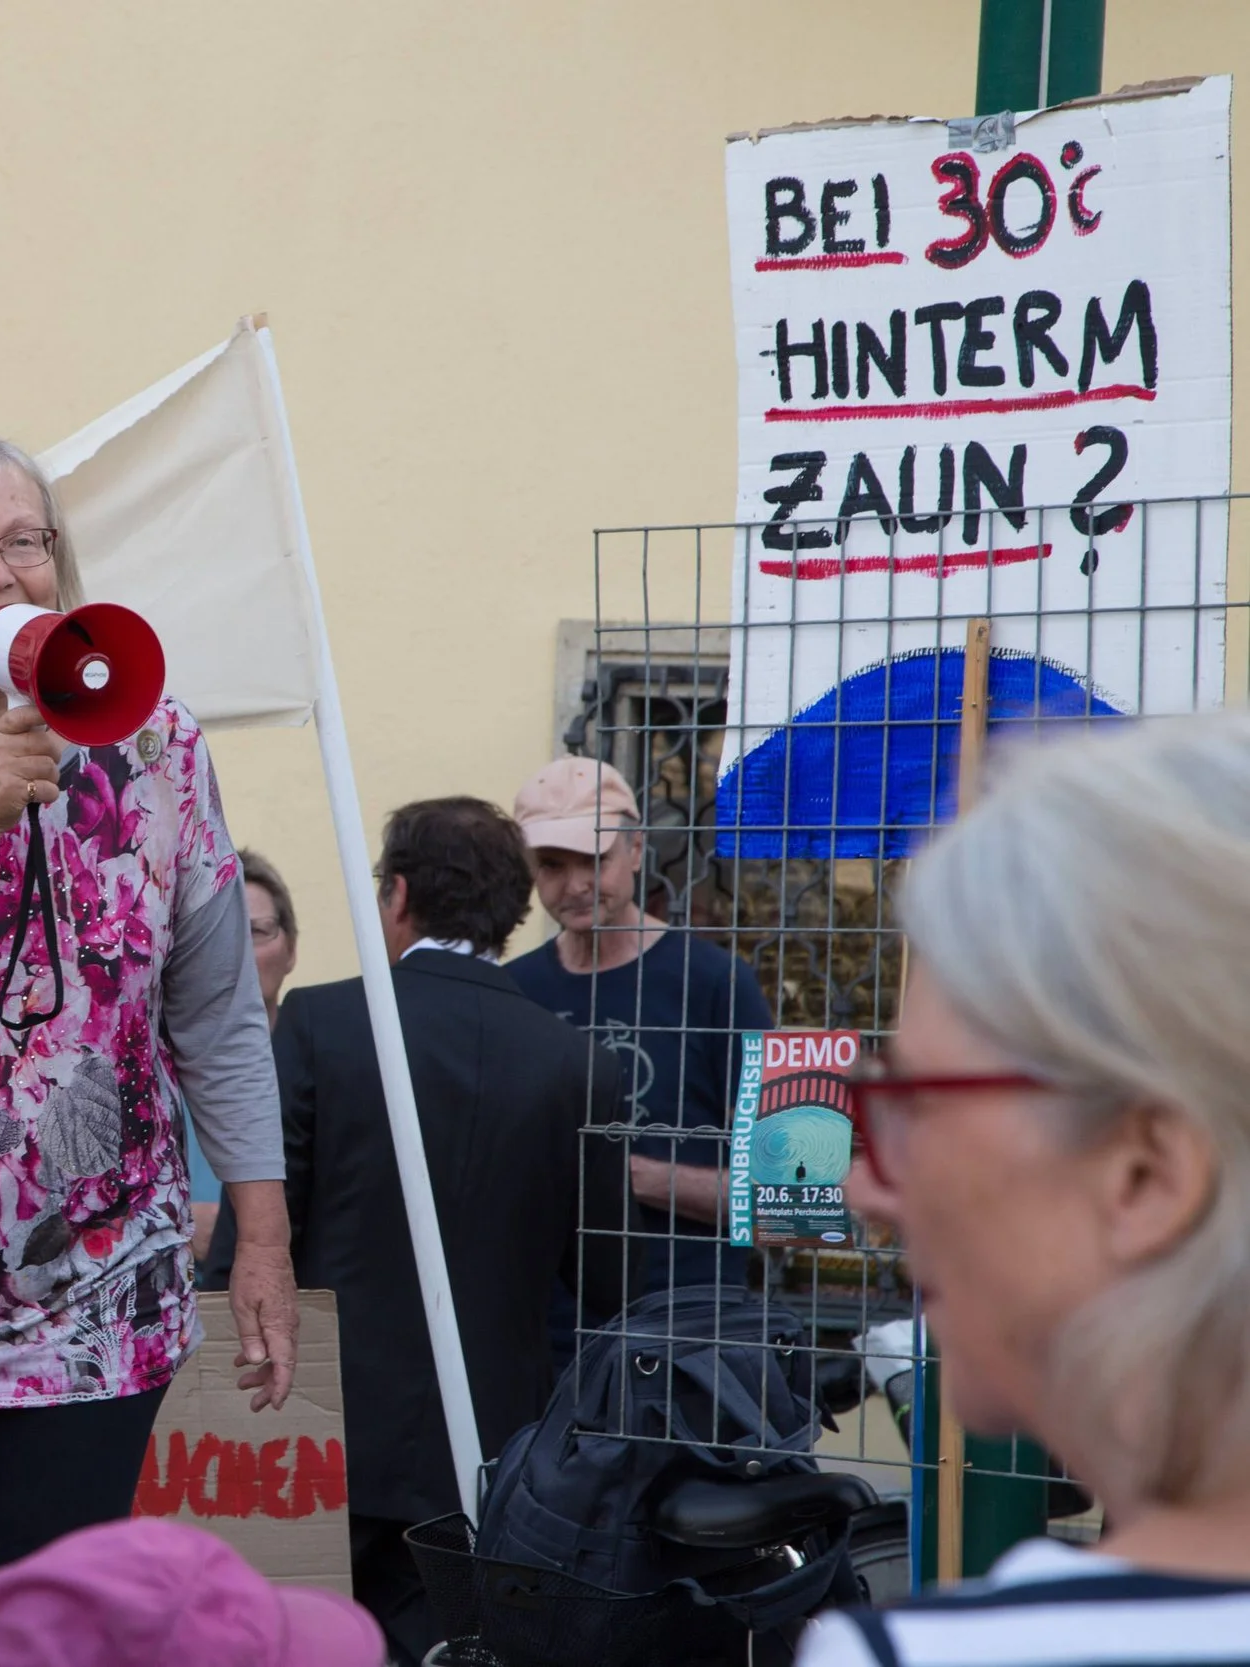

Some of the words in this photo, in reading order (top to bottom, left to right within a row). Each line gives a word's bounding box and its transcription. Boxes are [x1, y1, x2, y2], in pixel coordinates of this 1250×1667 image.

[764, 174, 891, 256] BEI
[759, 279, 1158, 402] HINTERM
[766, 1036, 856, 1068] DEMO
[731, 1037, 763, 1243] STEINBRUCHSEE
[756, 1186, 794, 1204] 20.6.
[801, 1187, 843, 1204] 17:30
[756, 1207, 793, 1217] Marktplatz
[794, 1208, 845, 1217] Perchtoldsdorf
[130, 1428, 349, 1520] UCHEN
